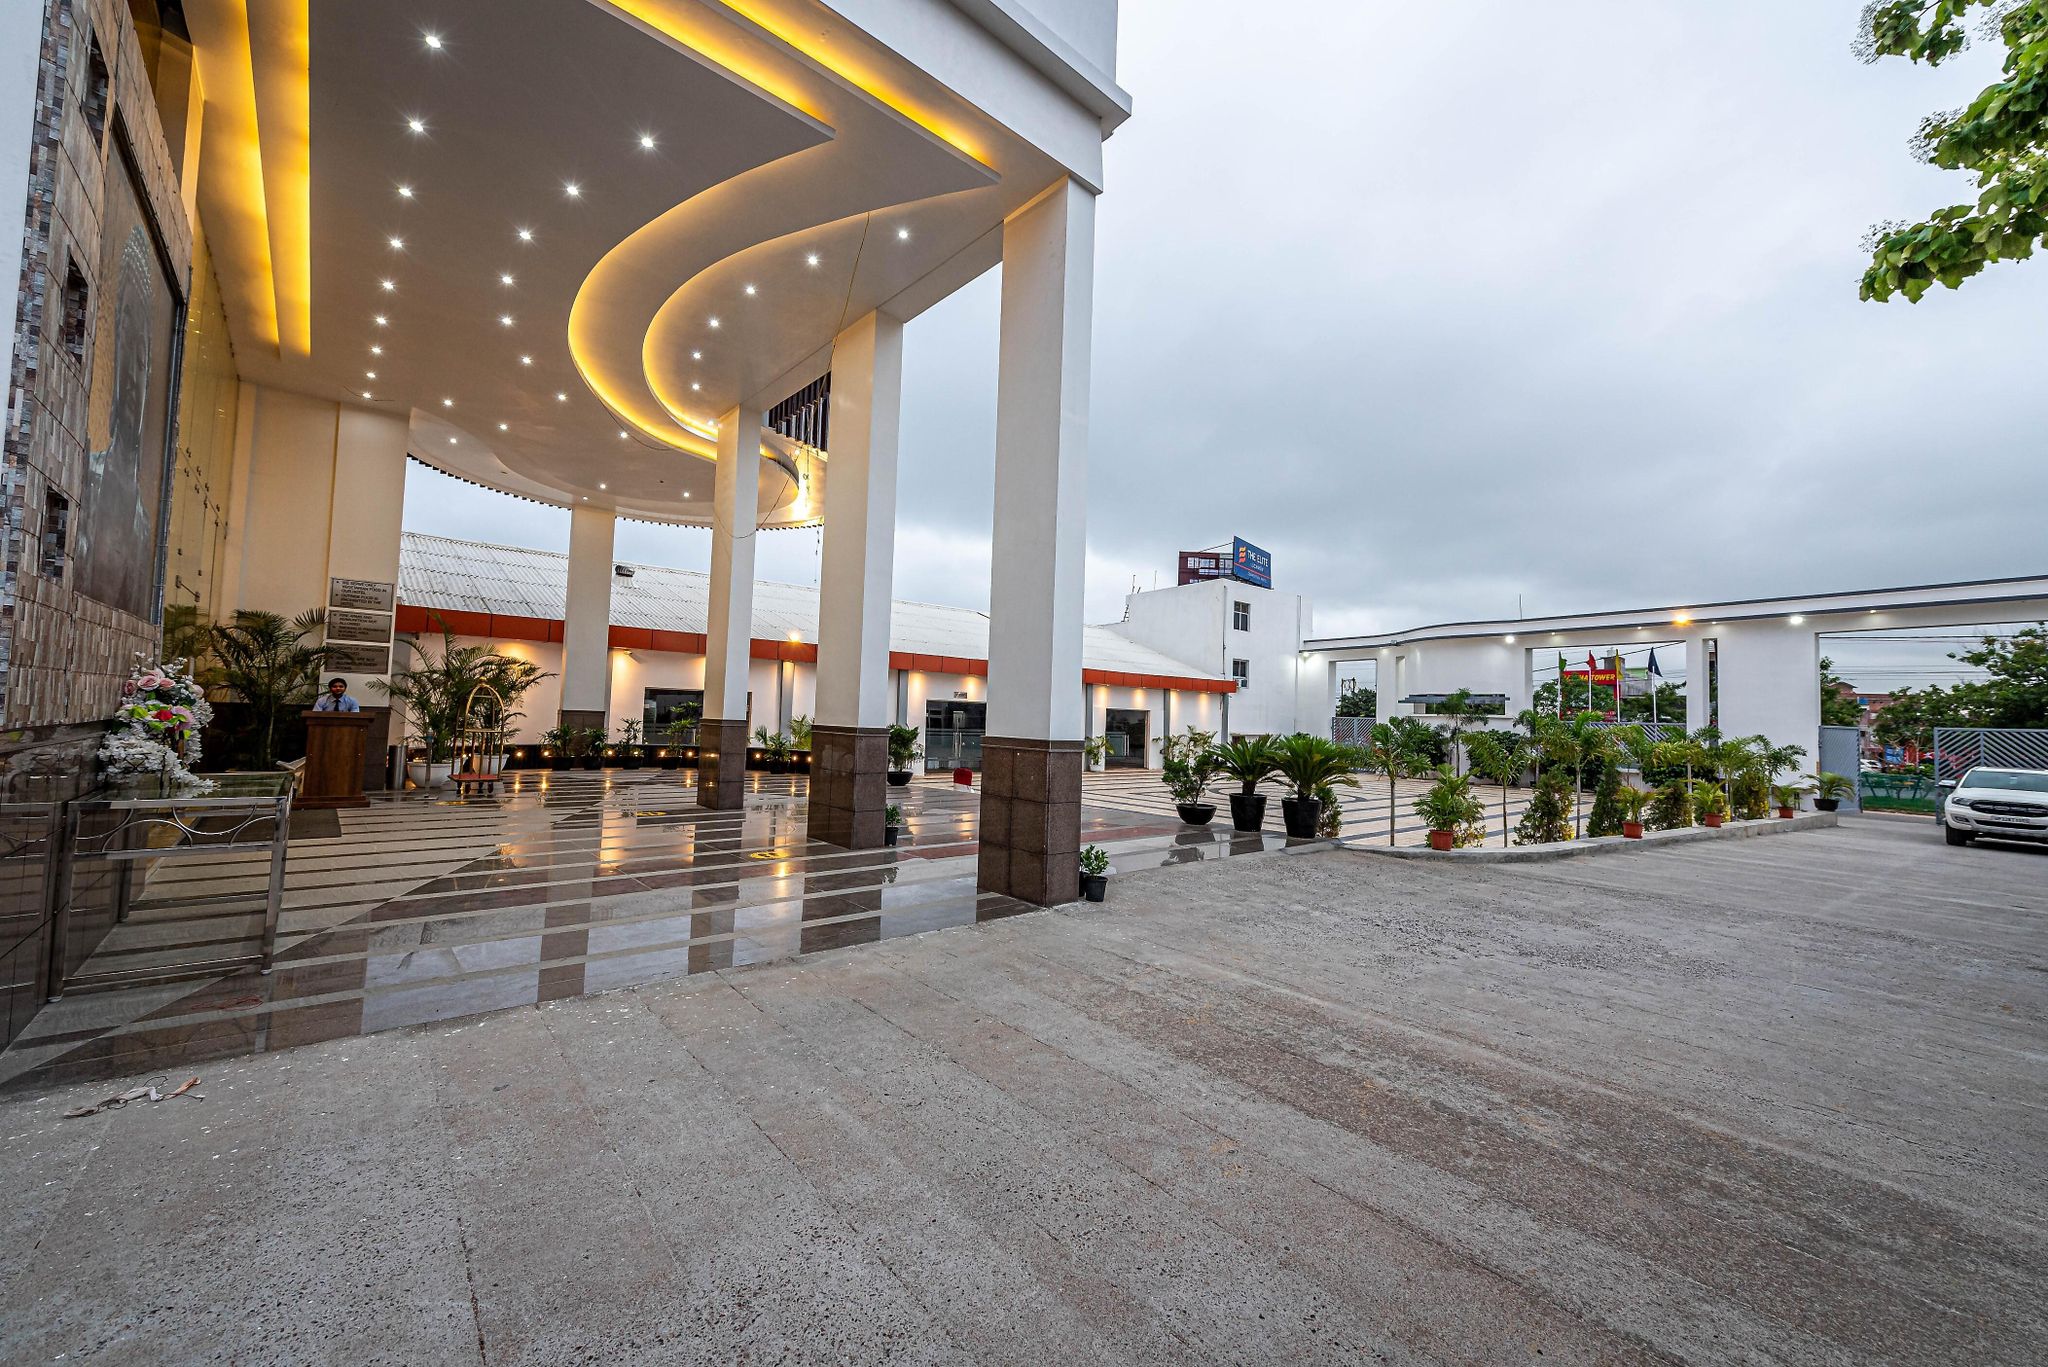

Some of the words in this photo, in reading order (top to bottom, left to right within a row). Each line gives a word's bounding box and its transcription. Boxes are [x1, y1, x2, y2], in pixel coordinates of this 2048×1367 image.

[1247, 549, 1256, 562] THE
[1256, 555, 1269, 567] ELITE
[1591, 673, 1616, 681] TOWER
